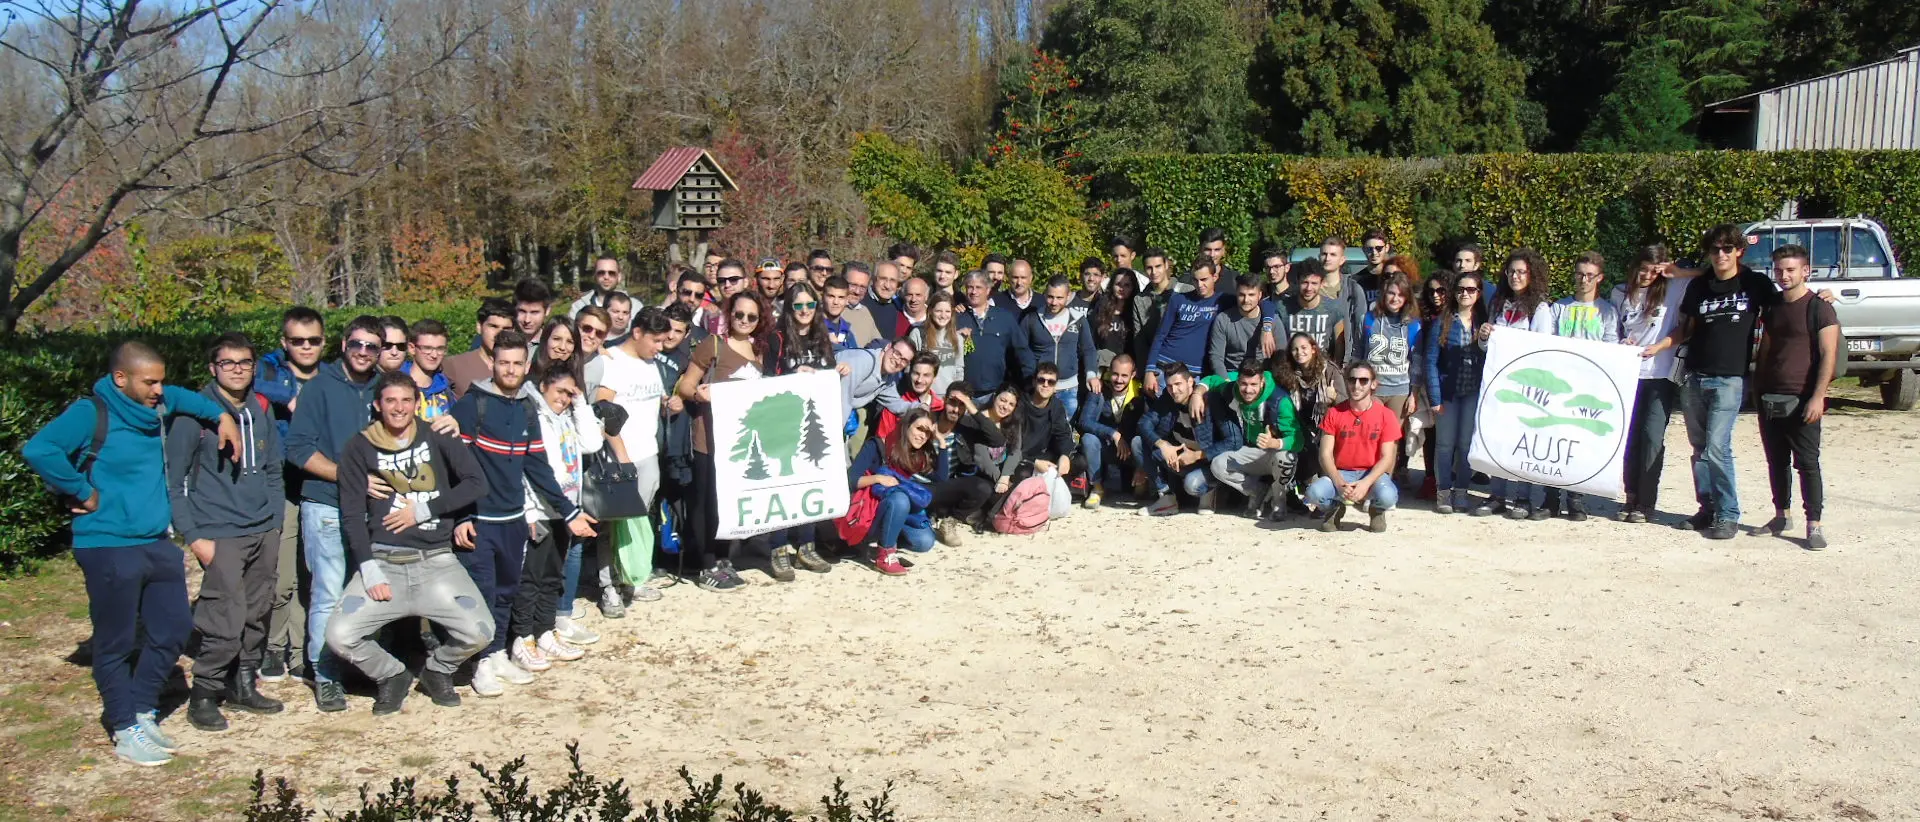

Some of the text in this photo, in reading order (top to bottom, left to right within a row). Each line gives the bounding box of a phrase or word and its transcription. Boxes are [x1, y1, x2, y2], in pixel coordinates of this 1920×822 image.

[1289, 314, 1329, 332] LET IT
[1367, 333, 1409, 365] 25
[1512, 432, 1580, 465] AUSF
[1520, 461, 1562, 477] ITALIA
[737, 488, 834, 527] F.A.G.
